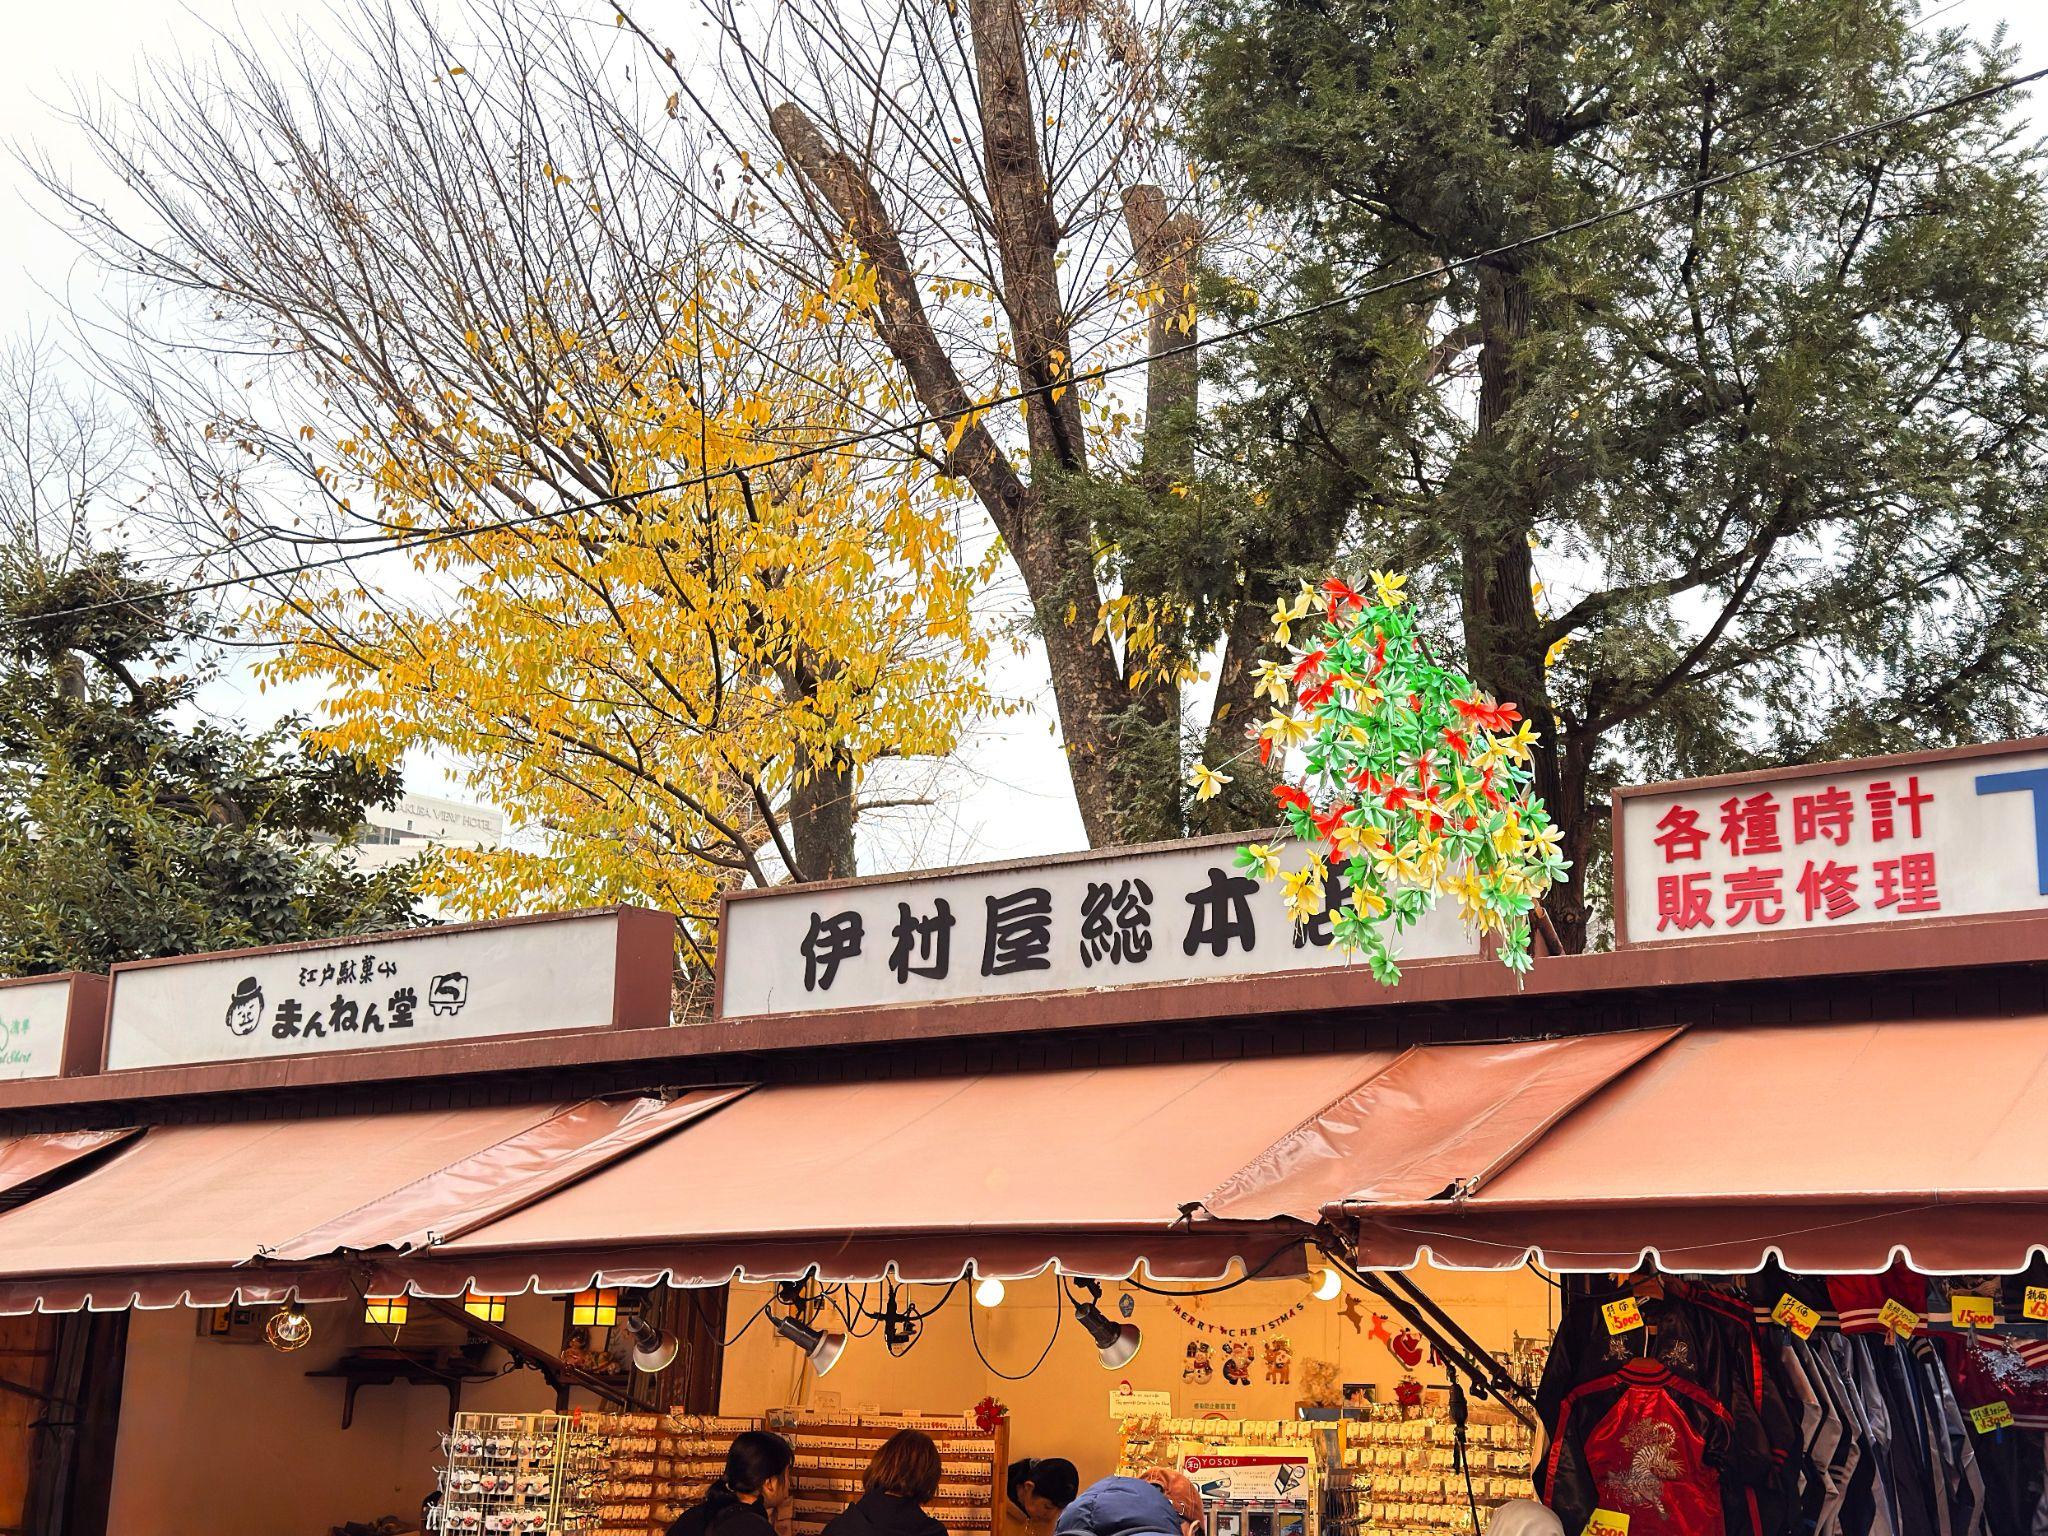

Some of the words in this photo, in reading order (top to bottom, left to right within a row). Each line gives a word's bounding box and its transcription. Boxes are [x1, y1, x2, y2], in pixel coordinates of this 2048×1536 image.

[462, 815, 490, 831] HOTEL
[1653, 776, 1935, 863] 各種時計
[1656, 851, 1942, 932] 販売修理
[299, 955, 397, 987] 江戸駄菓子
[271, 986, 418, 1039] まんねん堂
[1173, 1305, 1214, 1333] MERRY
[1229, 1302, 1304, 1337] CHRISTMAS
[1201, 1458, 1238, 1466] YOSOU
